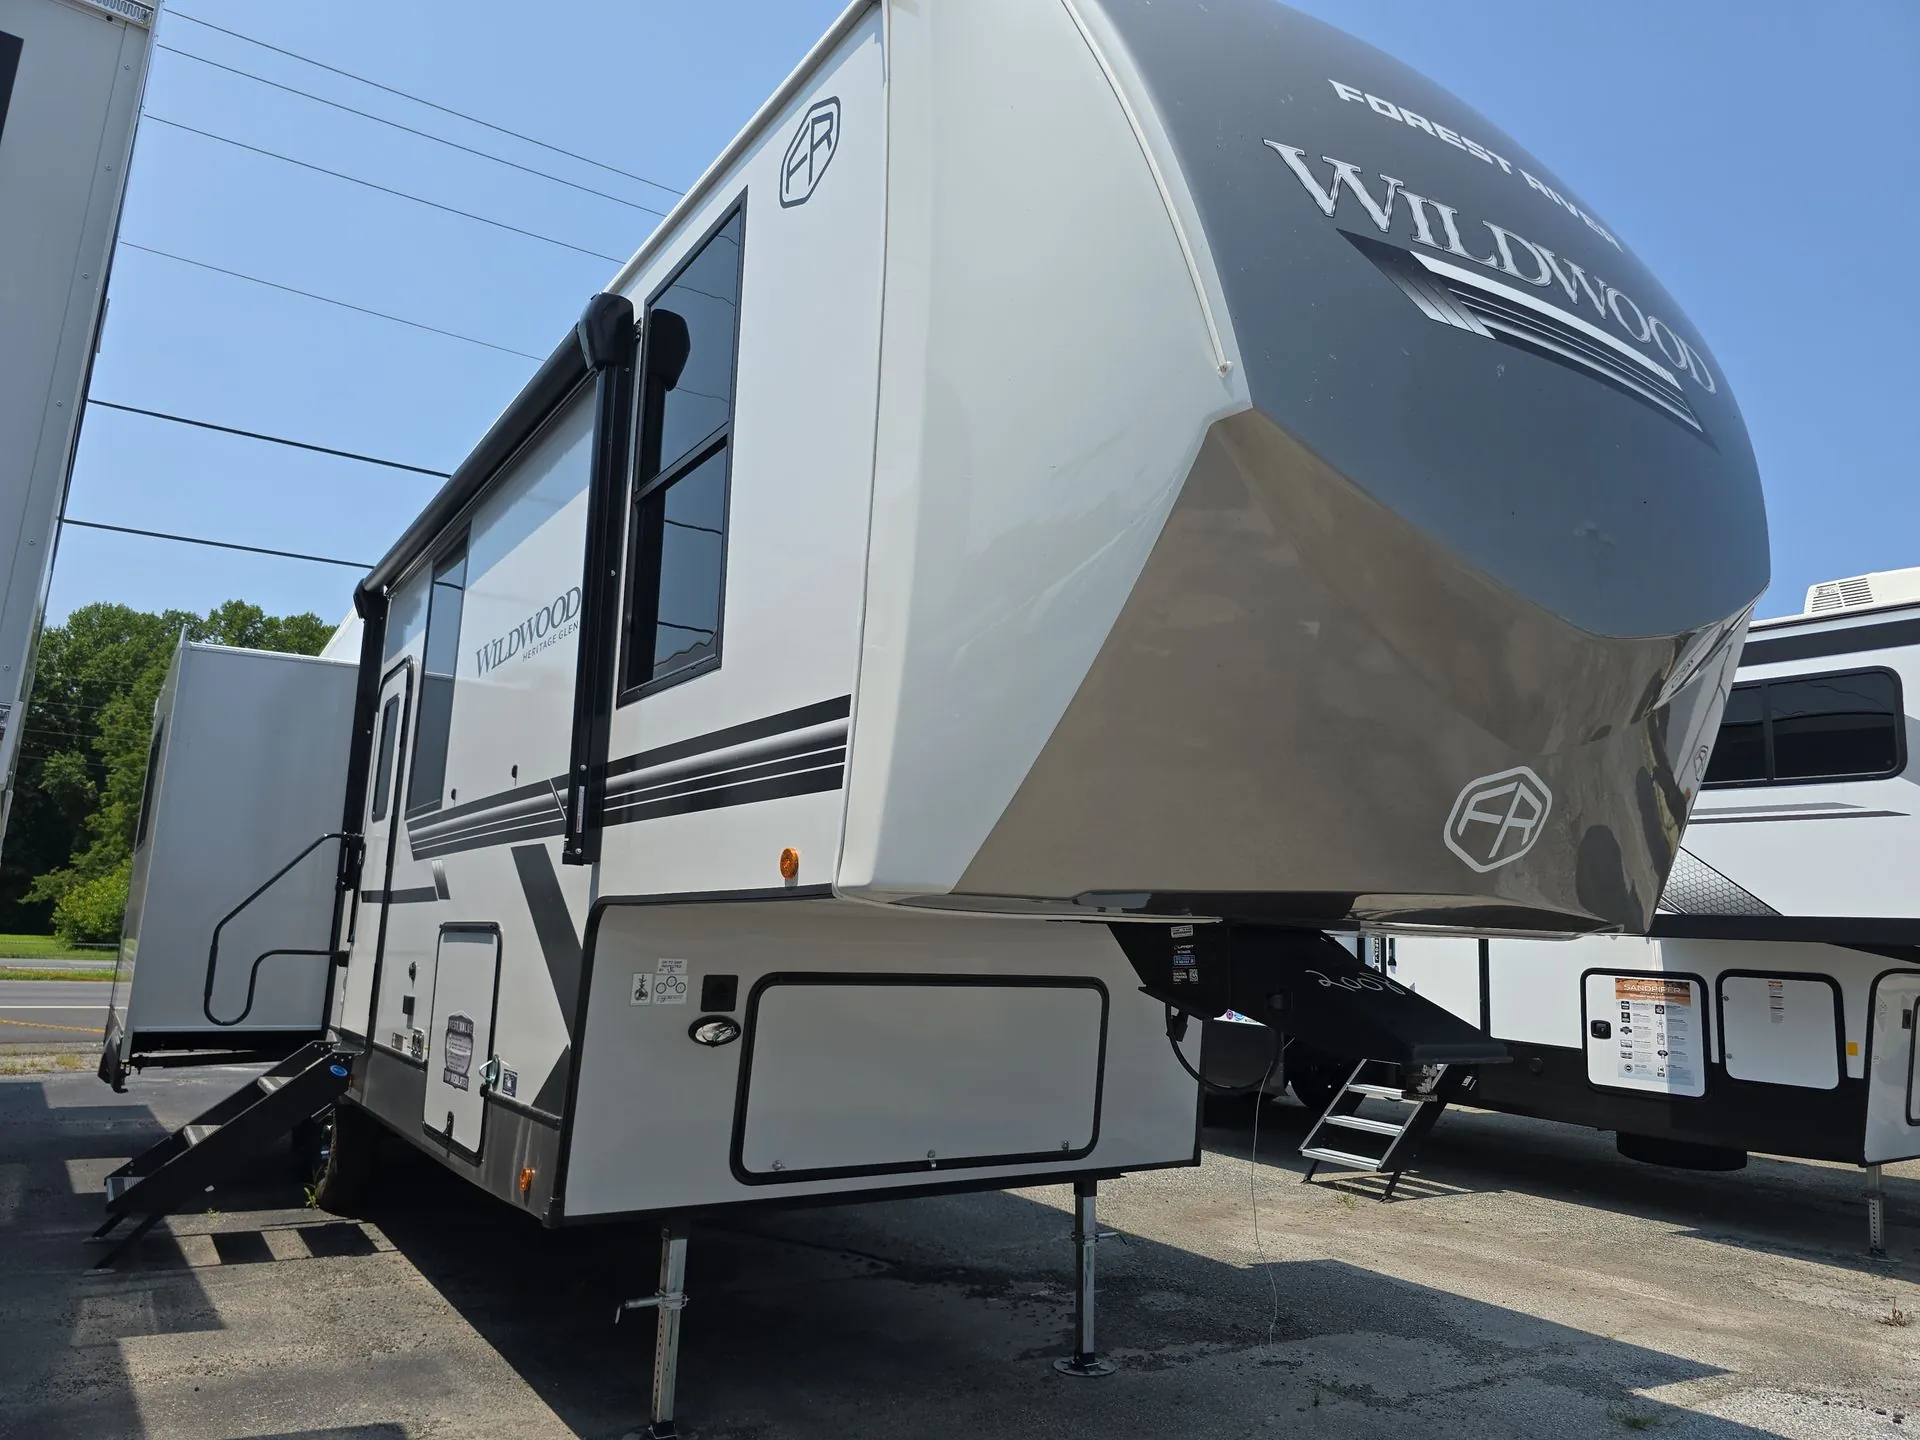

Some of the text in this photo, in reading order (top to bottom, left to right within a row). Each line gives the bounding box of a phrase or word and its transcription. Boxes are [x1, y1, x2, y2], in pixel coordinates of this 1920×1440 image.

[1328, 78, 1624, 253] FOREST RIVER
[1262, 137, 1718, 395] WILDWOOD
[476, 586, 581, 678] WILDWOOD
[521, 621, 579, 662] HERITAGE GLEN
[1623, 983, 1681, 994] SANDPIPER
